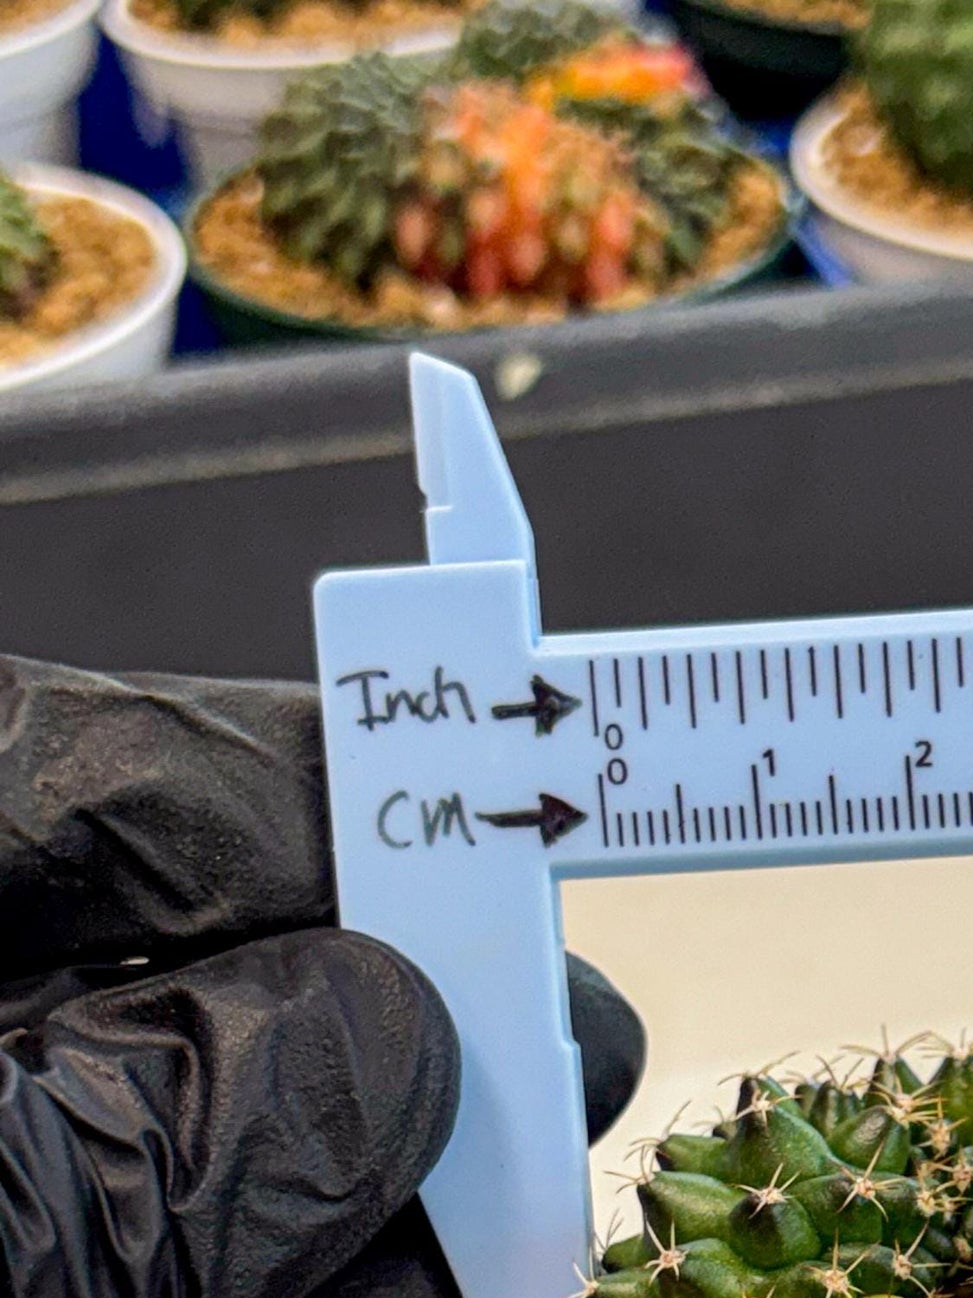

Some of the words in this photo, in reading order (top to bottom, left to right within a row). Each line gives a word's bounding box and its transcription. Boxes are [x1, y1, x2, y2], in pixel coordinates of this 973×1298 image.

[336, 666, 476, 732] Inch
[604, 723, 624, 751] 0
[606, 757, 628, 786] 0
[762, 748, 776, 777] 1
[914, 740, 933, 768] 2
